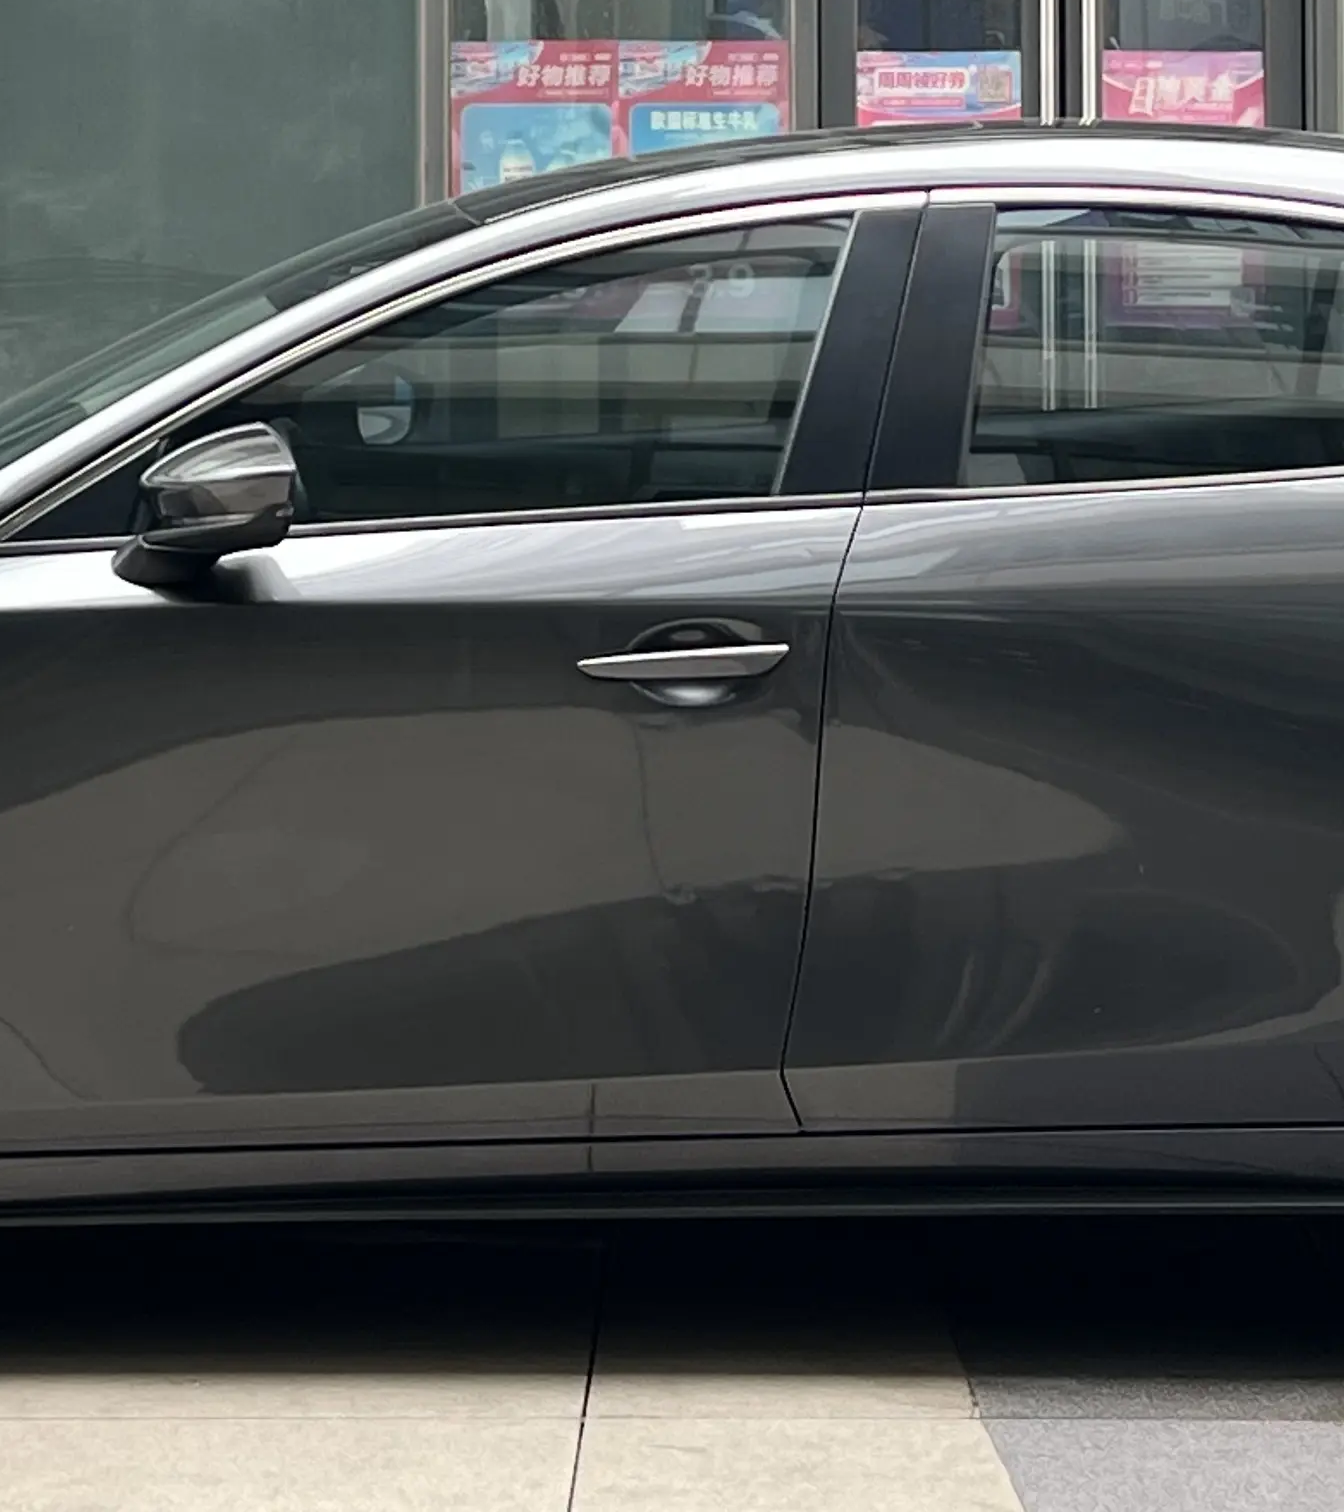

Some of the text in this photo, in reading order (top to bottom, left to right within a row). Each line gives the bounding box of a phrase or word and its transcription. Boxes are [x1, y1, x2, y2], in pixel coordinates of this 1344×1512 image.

[516, 64, 612, 87] 好物推荐
[685, 64, 779, 87] 好物推荐
